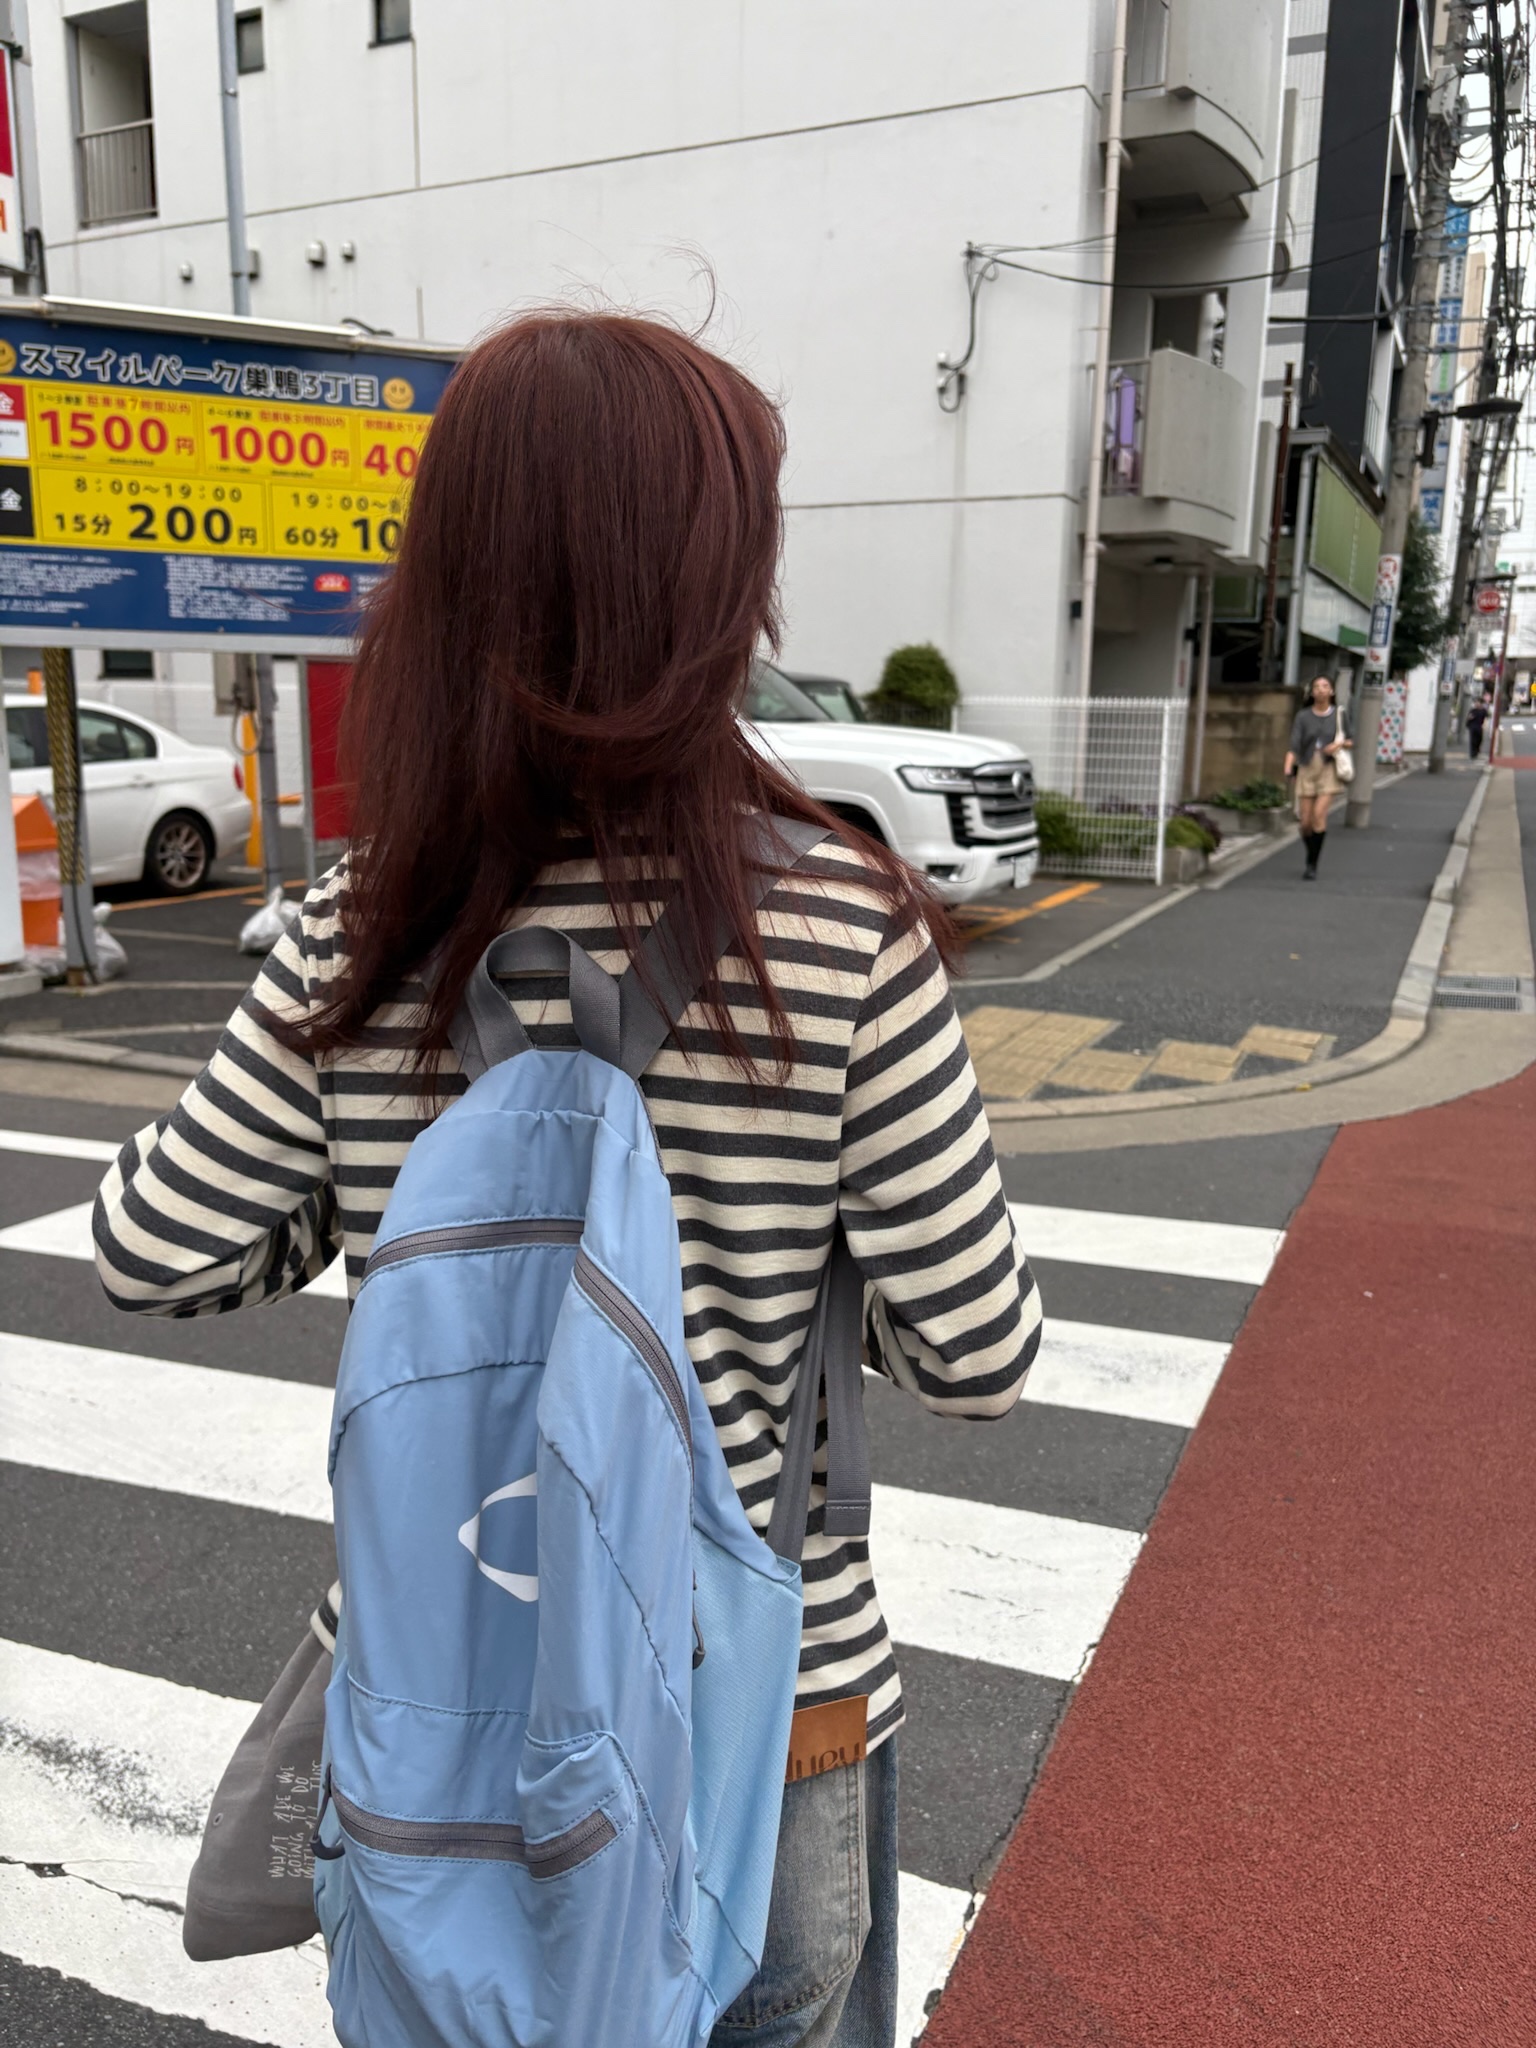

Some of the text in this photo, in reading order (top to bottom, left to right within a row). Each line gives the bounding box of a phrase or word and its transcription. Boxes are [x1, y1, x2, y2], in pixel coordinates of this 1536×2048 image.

[20, 343, 379, 407] スマイルパーク巣鴨3丁目
[275, 1764, 295, 1784] WE
[290, 1776, 309, 1793] DO
[290, 1803, 307, 1821] TO
[268, 1834, 289, 1878] WHAT
